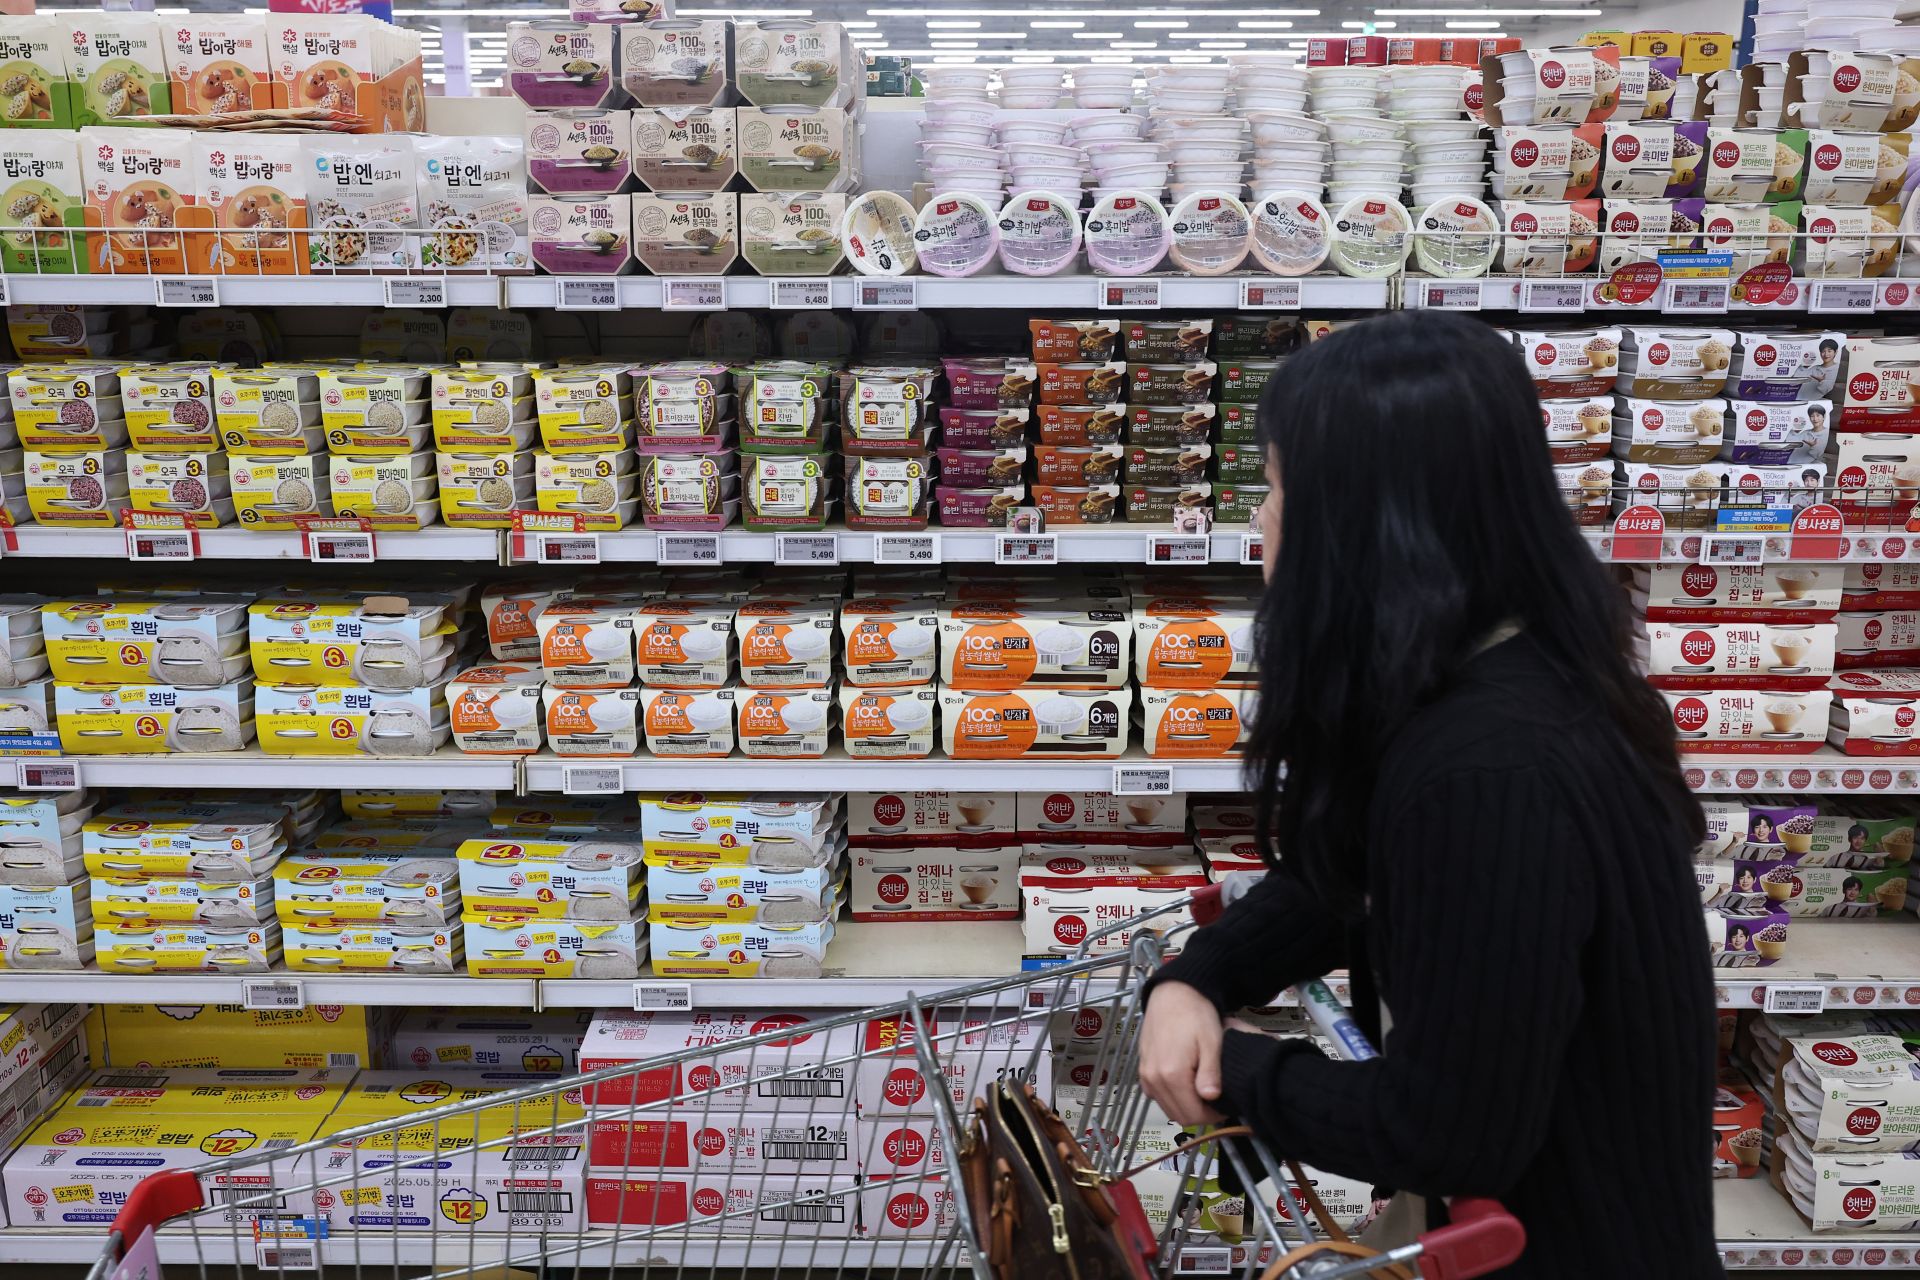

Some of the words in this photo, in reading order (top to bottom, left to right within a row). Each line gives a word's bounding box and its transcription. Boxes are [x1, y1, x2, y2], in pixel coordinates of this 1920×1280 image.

[74, 44, 89, 55] 백설
[95, 39, 131, 56] 밥이랑
[131, 41, 147, 50] 야채
[177, 43, 193, 54] 백설
[199, 38, 235, 56] 밥이랑
[236, 39, 253, 49] 해물
[547, 43, 568, 58] 쎈쿡
[1542, 66, 1564, 81] 햇반
[1836, 72, 1860, 86] 햇반
[1568, 75, 1592, 88] 잡곡밥
[1862, 81, 1893, 96] 현미쌀밥
[566, 131, 588, 143] 쎈쿡
[589, 134, 614, 144] 현미밥
[690, 133, 717, 143] 통곡물밥
[780, 129, 802, 141] 쎈쿡
[1615, 145, 1638, 159] 햇반
[1743, 143, 1768, 152] 부드러운
[1540, 154, 1567, 167] 잡곡밥
[1642, 150, 1668, 163] 흑미밥
[1715, 147, 1739, 162] 햇반
[1818, 150, 1841, 165] 햇반
[3, 158, 46, 177] 밥이랑
[46, 159, 64, 170] 야채
[97, 159, 115, 172] 백설
[122, 156, 163, 175] 밥이랑
[163, 158, 182, 169] 해물
[1844, 156, 1876, 169] 현미쌀밥
[209, 166, 227, 178] 백설
[234, 160, 275, 179] 밥이랑
[275, 163, 292, 173] 해물
[374, 169, 401, 181] 쇠고기
[691, 217, 718, 228] 통곡물밥
[783, 213, 804, 225] 쎈쿡
[931, 223, 957, 238] 흑미밥
[1015, 221, 1042, 235] 흑미밥
[1105, 221, 1131, 235] 흑미밥
[1188, 222, 1214, 235] 오미밥
[1350, 223, 1377, 238] 현미밥
[191, 293, 214, 303] 1,980
[419, 294, 442, 304] 2,300
[592, 295, 615, 306] 6,480
[699, 295, 722, 306] 6,480
[805, 295, 828, 306] 6,480
[1557, 298, 1580, 308] 6,480
[1847, 299, 1871, 309] 6,480
[1036, 338, 1054, 349] 솔반
[1537, 348, 1555, 360] 햇반
[1756, 349, 1777, 361] 햇반
[1881, 369, 1910, 380] 언제나
[953, 386, 970, 396] 솔반
[1852, 379, 1876, 393] 햇반
[48, 388, 66, 398] 오곡
[160, 388, 178, 398] 오곡
[262, 388, 294, 403] 발아현미
[368, 388, 402, 402] 발아현미
[465, 387, 489, 400] 찰현미
[569, 387, 593, 399] 찰현미
[58, 464, 76, 475] 오곡
[277, 466, 310, 480] 발아현미
[377, 466, 408, 481] 발아현미
[468, 466, 490, 478] 찰현미
[132, 513, 184, 527] 행사상품
[523, 513, 575, 528] 행사상품
[1619, 517, 1662, 531] 행사상품
[1797, 517, 1841, 531] 행사상품
[1884, 540, 1905, 555] 햇반
[693, 550, 716, 559] 6,490
[811, 550, 834, 559] 5,490
[909, 550, 932, 559] 5,490
[131, 621, 158, 636] 흰밥
[336, 623, 362, 638] 흰밥
[552, 635, 575, 647] 100
[1726, 631, 1760, 643] 언제나
[554, 646, 583, 657] 농협쌀밥
[1090, 636, 1118, 655] 6개입
[1684, 639, 1713, 656] 햇반
[1727, 644, 1760, 656] 맛있는
[966, 649, 1002, 661] 농협쌀밥
[149, 692, 178, 707] 흰밥
[655, 704, 680, 717] 100
[655, 716, 685, 725] 농협쌀밥
[597, 781, 619, 790] 4,980
[1147, 782, 1169, 792] 8,980
[735, 820, 760, 835] 큰밥
[172, 839, 192, 849] 작은밥
[917, 863, 953, 877] 언제나
[551, 874, 576, 889] 큰밥
[880, 882, 906, 897] 햇반
[1057, 922, 1083, 938] 햇반
[277, 997, 298, 1005] 6,690
[666, 998, 689, 1008] 7,980
[475, 1049, 501, 1063] 흰밥
[1818, 1047, 1851, 1061] 햇반
[887, 1080, 922, 1096] 햇반
[1850, 1114, 1878, 1129] 햇반
[102, 1127, 153, 1140] 오뚜기밥
[213, 1138, 234, 1152] 12
[57, 1186, 90, 1198] 오뚜기밥
[1880, 1184, 1915, 1196] 부드러운
[98, 1191, 127, 1205] 흰밥
